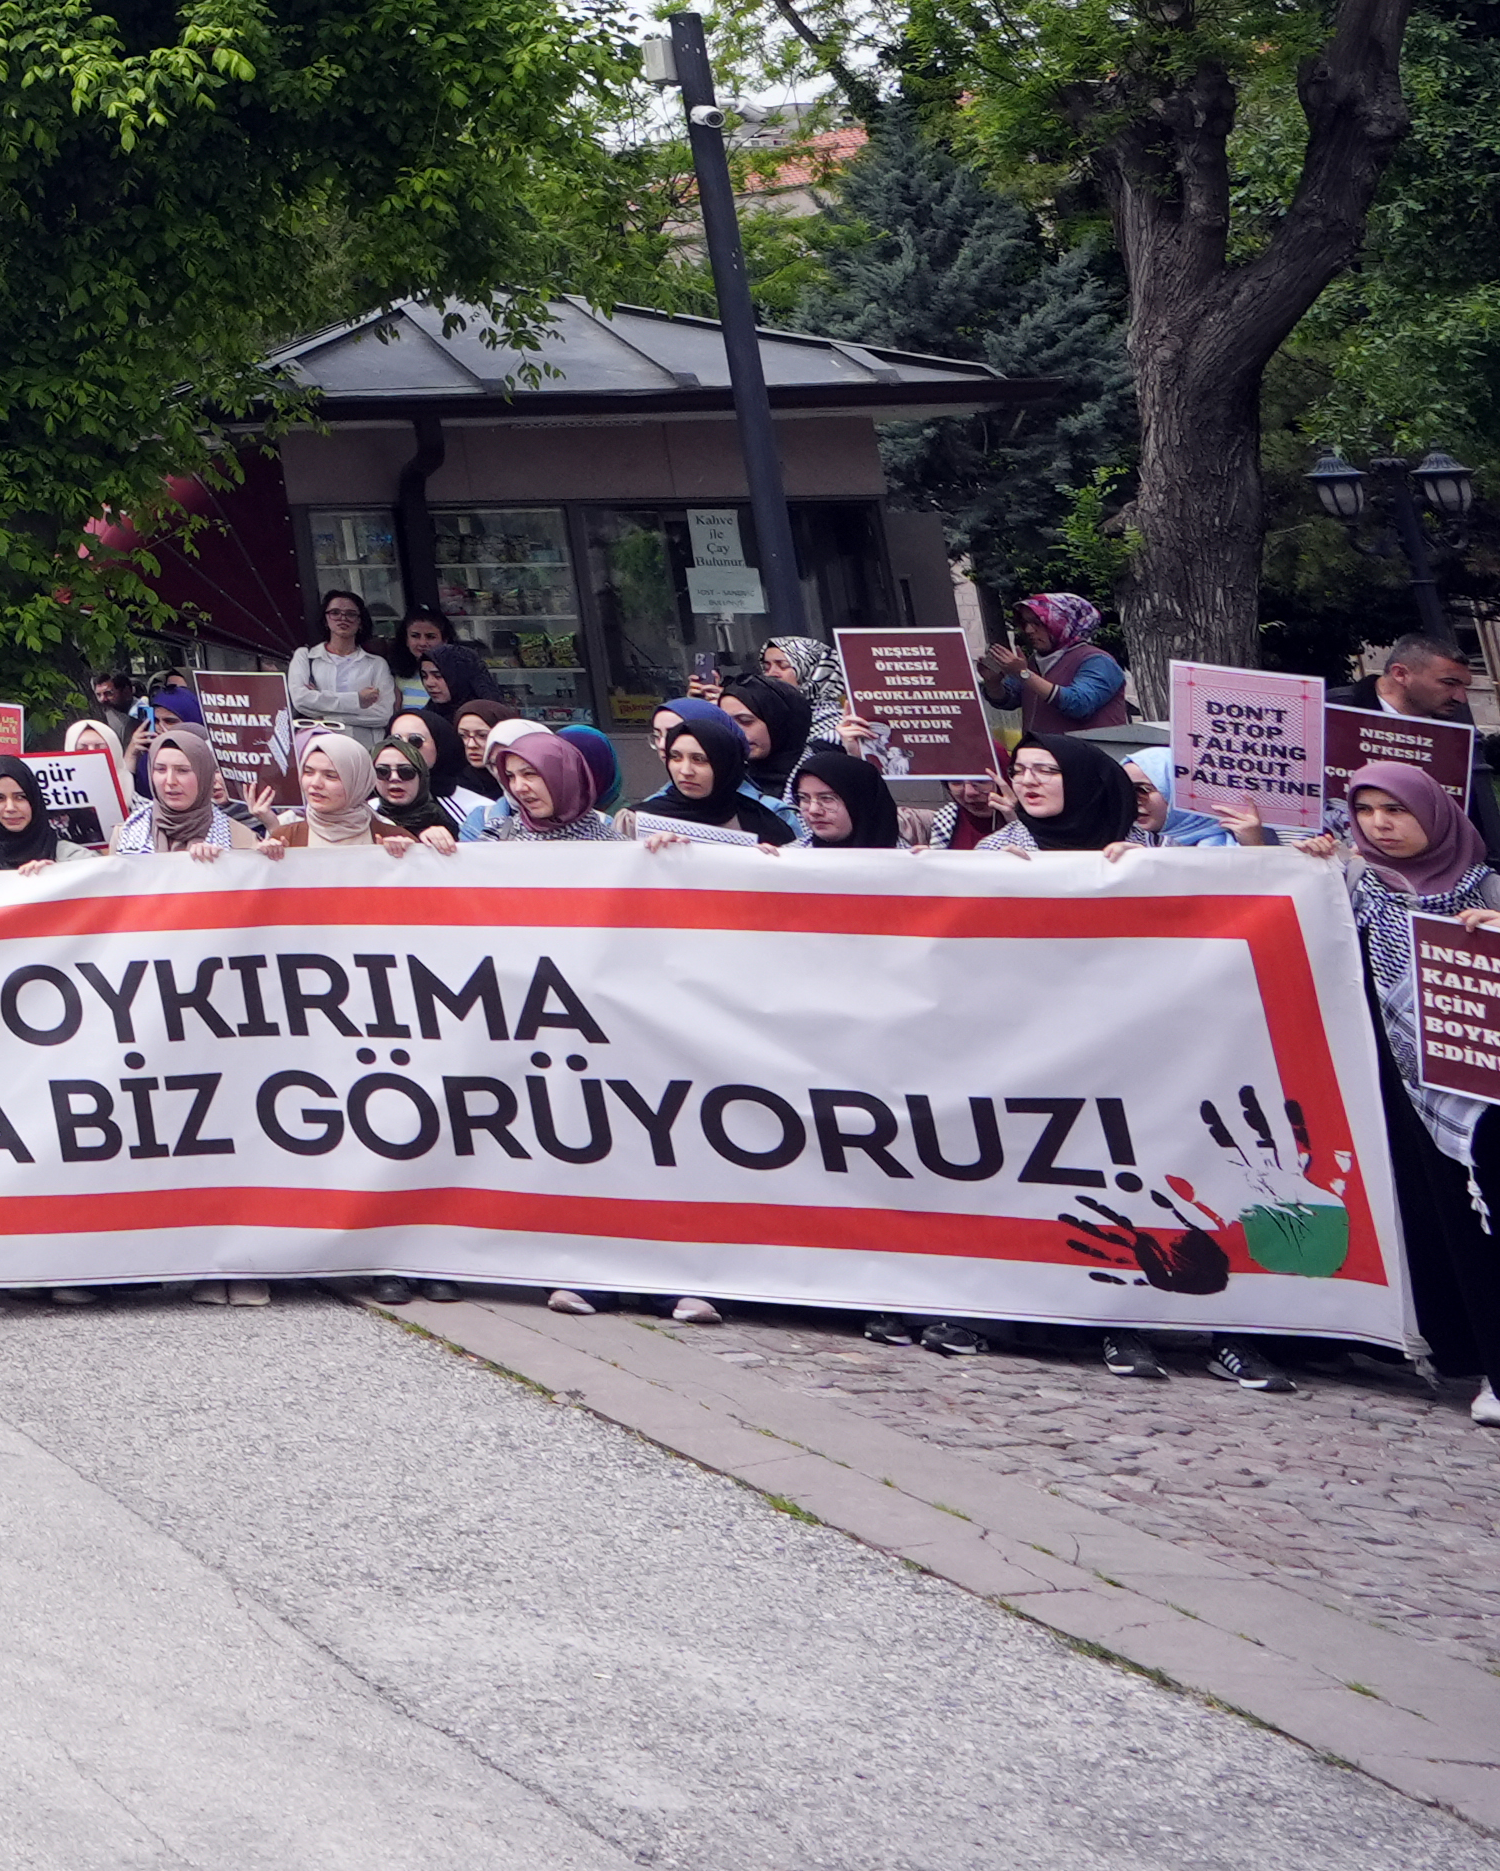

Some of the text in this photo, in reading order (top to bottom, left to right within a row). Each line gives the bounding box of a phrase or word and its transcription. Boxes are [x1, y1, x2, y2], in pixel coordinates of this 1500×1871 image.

[695, 515, 733, 525] Kahve
[707, 543, 730, 555] Çay
[871, 645, 936, 658] NEŞESİZ
[875, 660, 939, 671] ÖFKESİZ
[884, 675, 936, 686] HİSSİZ
[201, 690, 250, 708] İNSAN
[853, 690, 976, 702] ÇOCUKLARIMIZI
[205, 711, 273, 727] KALMAK
[873, 705, 962, 716] POŞETLERE
[1206, 701, 1288, 723] DON'T
[888, 720, 953, 729] KOYDUK
[1211, 720, 1282, 739] STOP
[209, 728, 238, 747] İÇİN
[902, 734, 951, 744] KIZIM
[1187, 733, 1307, 761] TALKING
[1359, 727, 1434, 748] NEŞESİZ
[214, 748, 272, 765] BOYKOT
[1359, 741, 1432, 762] ÖFKESİZ
[1199, 754, 1291, 777] ABOUT
[36, 763, 76, 789] gür
[1174, 765, 1321, 797] PALESTINE
[44, 786, 89, 805] stin
[1422, 967, 1500, 998] KALM
[1423, 989, 1486, 1019] İÇİN
[1424, 1015, 1500, 1047] BOYK
[1426, 1040, 1500, 1071] EDİN
[47, 1050, 235, 1162] BİZ
[255, 1047, 1140, 1193] GÖRÜYORUZ!
